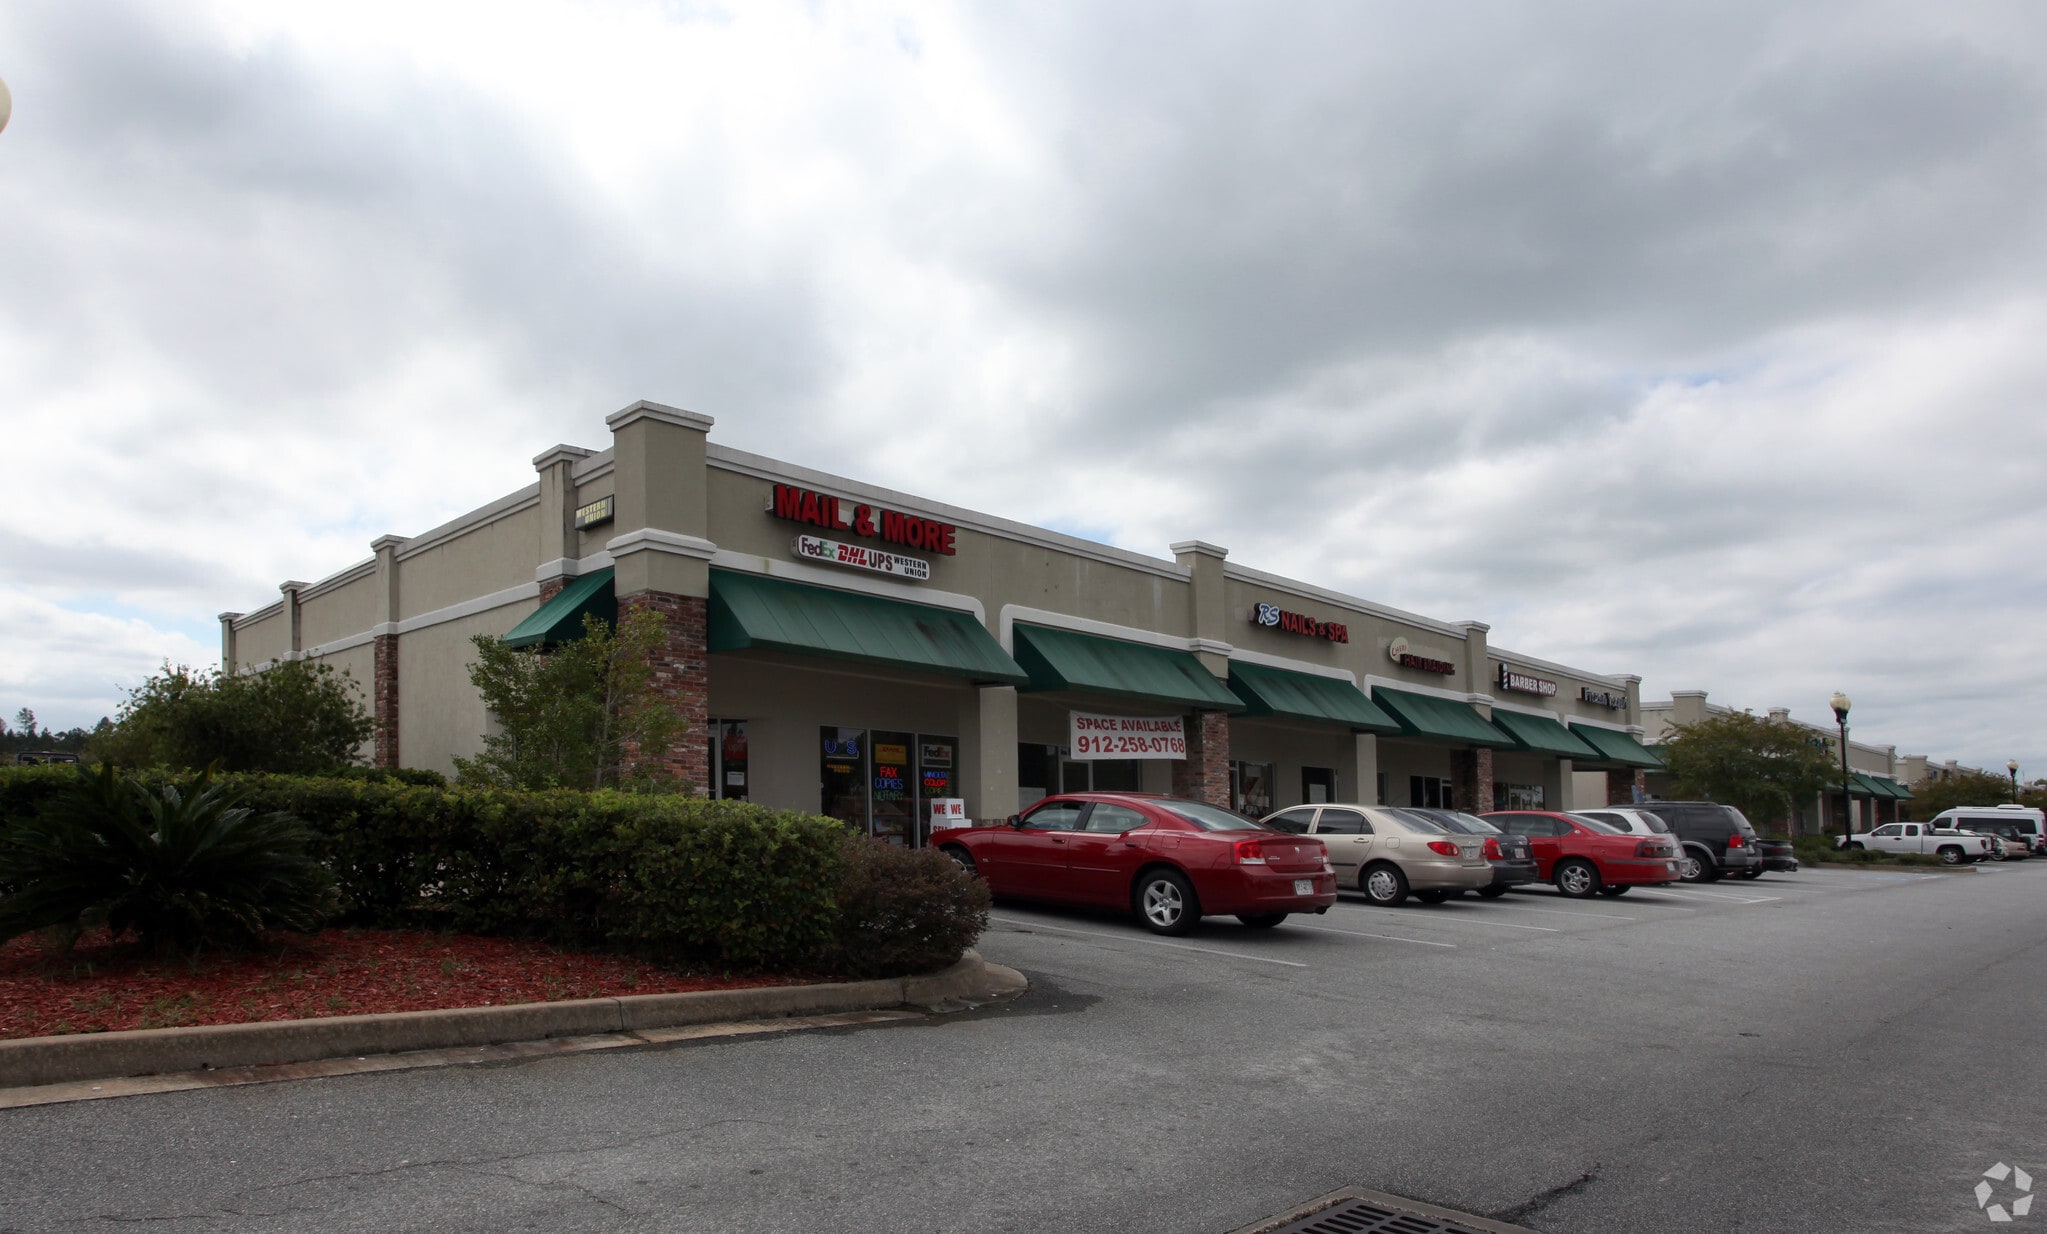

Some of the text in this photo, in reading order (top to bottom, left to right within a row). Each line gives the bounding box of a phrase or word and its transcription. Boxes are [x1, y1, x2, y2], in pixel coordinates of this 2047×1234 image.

[576, 499, 606, 518] WESTERN
[585, 509, 607, 524] UNION
[774, 483, 956, 556] MAIL & MORE
[801, 537, 893, 571] FedEx DHL UPS
[894, 556, 927, 570] WESTERN
[904, 567, 927, 578] UNION
[1258, 603, 1348, 644] RS NAILS & SPA
[1405, 654, 1423, 669] HAIR
[1510, 674, 1556, 696] BARBER SHOP
[1077, 717, 1182, 732] SPACE AVAILABLE
[924, 746, 950, 757] FedEx
[1077, 735, 1185, 754] 912-258-0768
[879, 766, 898, 778] FAX
[874, 777, 904, 790] COPIES
[873, 790, 904, 800] NOTARY
[933, 803, 946, 815] WE
[950, 803, 962, 815] WE
